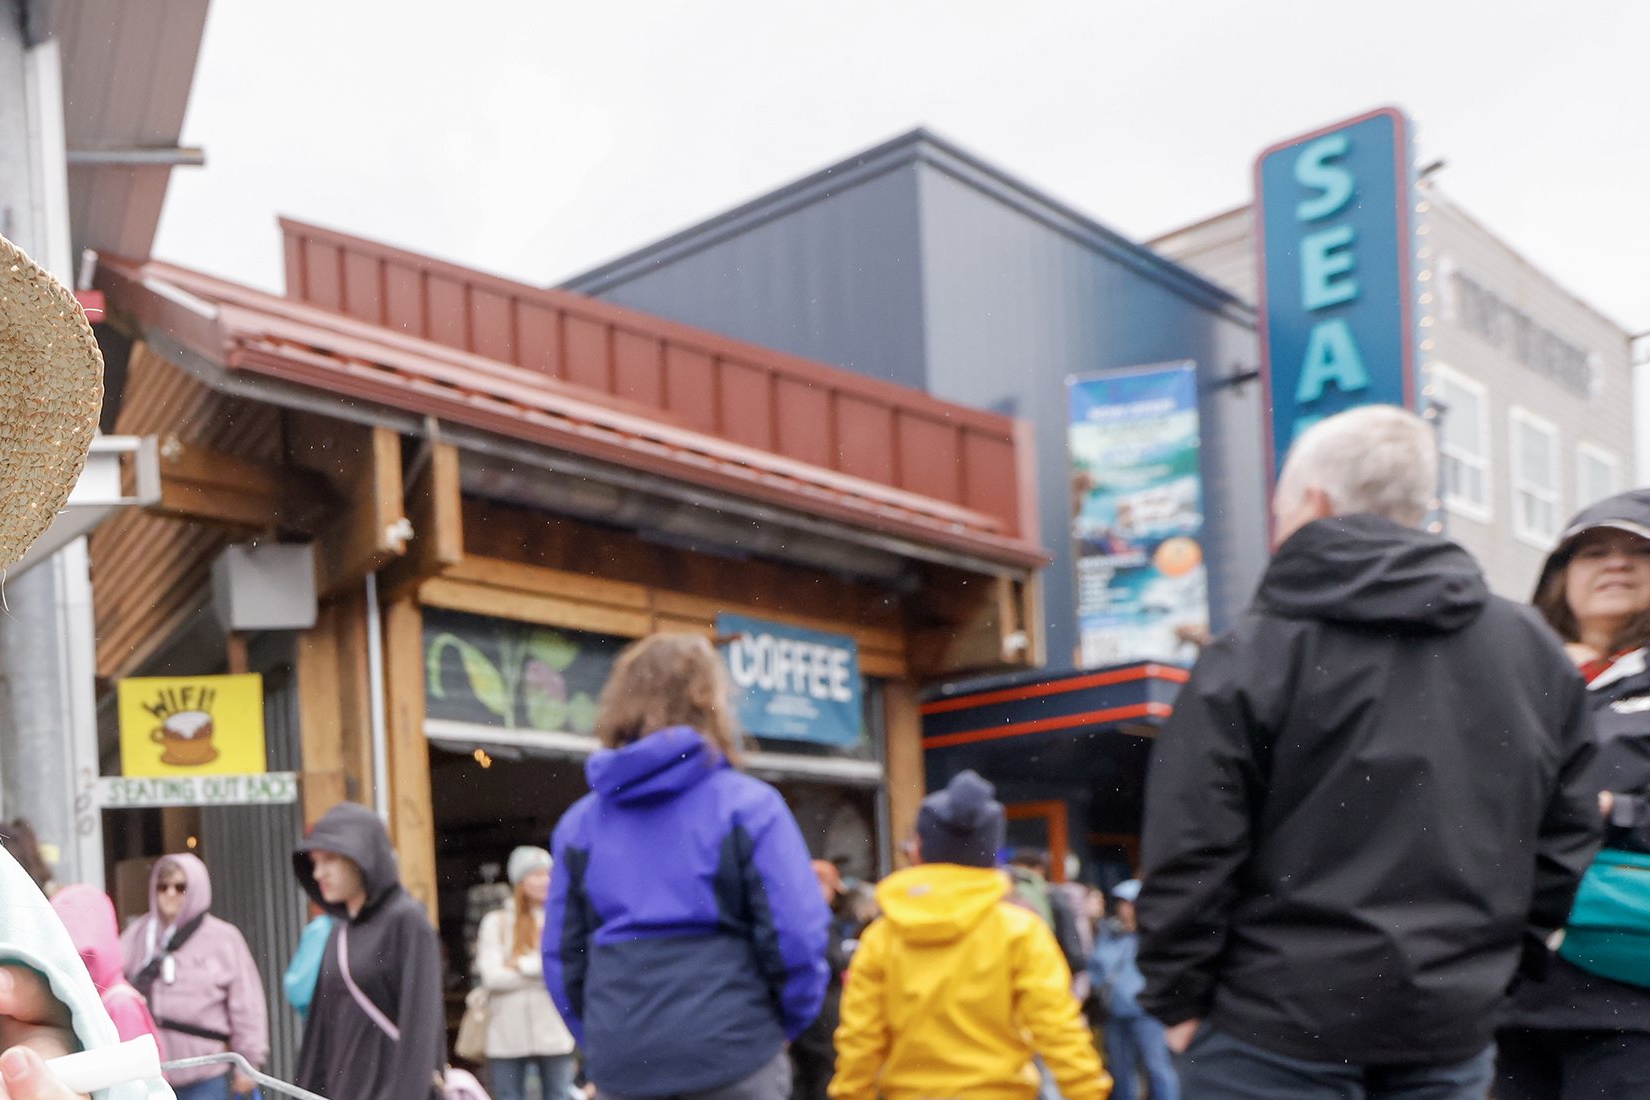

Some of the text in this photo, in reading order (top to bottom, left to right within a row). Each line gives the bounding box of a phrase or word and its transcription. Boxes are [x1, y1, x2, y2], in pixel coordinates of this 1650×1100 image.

[1292, 133, 1372, 440] SEA
[729, 632, 853, 703] COFFEE
[108, 777, 196, 804] SEATING
[202, 776, 239, 801] OUT
